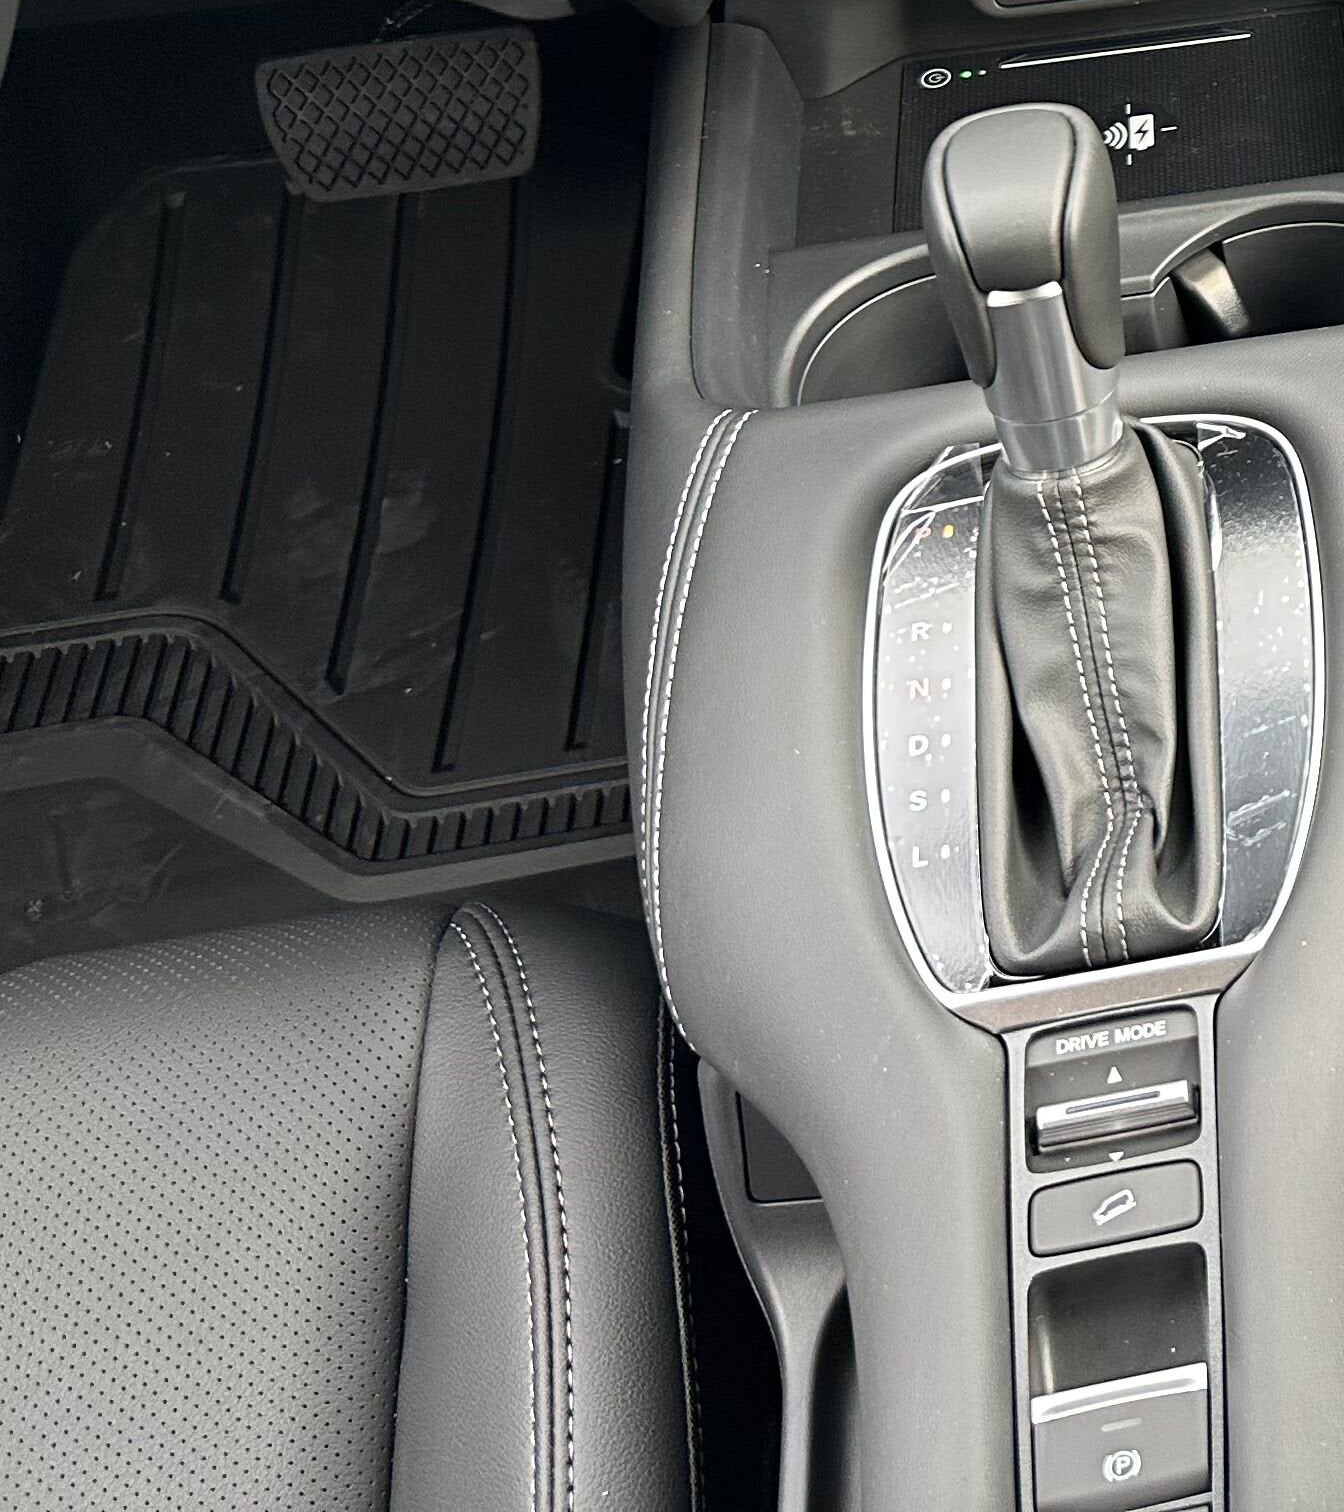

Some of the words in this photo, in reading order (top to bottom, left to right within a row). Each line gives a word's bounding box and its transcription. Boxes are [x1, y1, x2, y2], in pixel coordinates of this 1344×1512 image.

[911, 621, 930, 642] R
[908, 677, 930, 699] N
[908, 734, 929, 757] D
[909, 789, 929, 812] S
[911, 846, 929, 869] L
[1055, 1030, 1110, 1056] DRIVE
[1114, 1019, 1167, 1044] MODE
